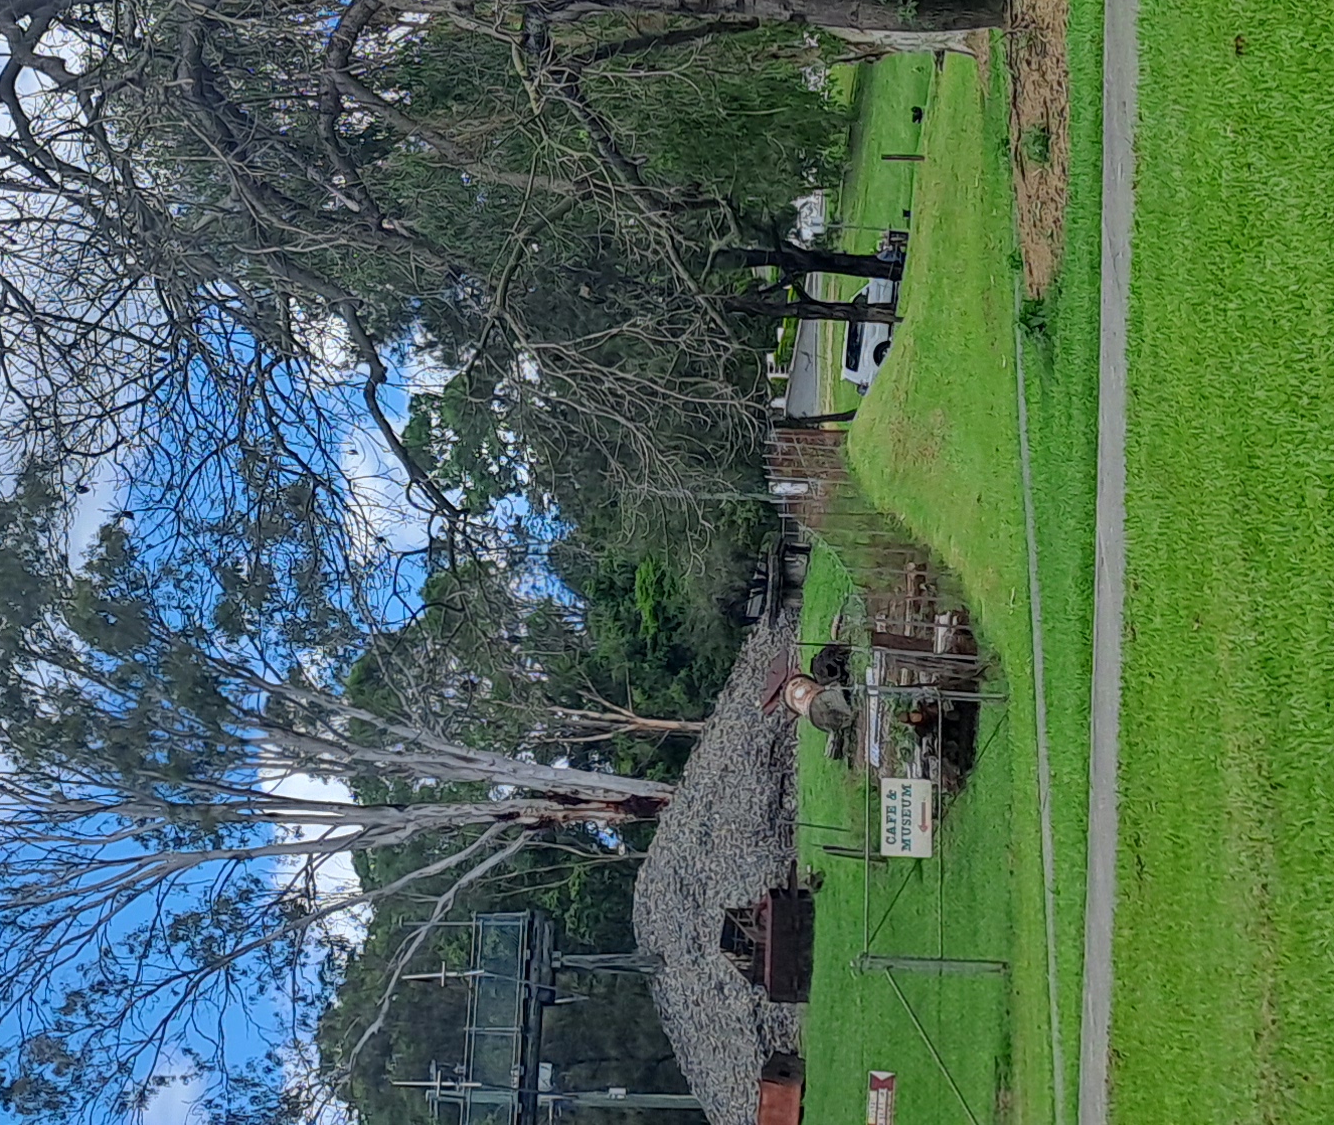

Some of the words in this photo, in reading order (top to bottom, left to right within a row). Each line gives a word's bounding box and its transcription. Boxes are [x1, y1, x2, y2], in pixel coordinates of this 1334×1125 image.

[886, 789, 897, 801] &
[886, 805, 897, 845] CAFE
[901, 783, 912, 852] MUSEUM
